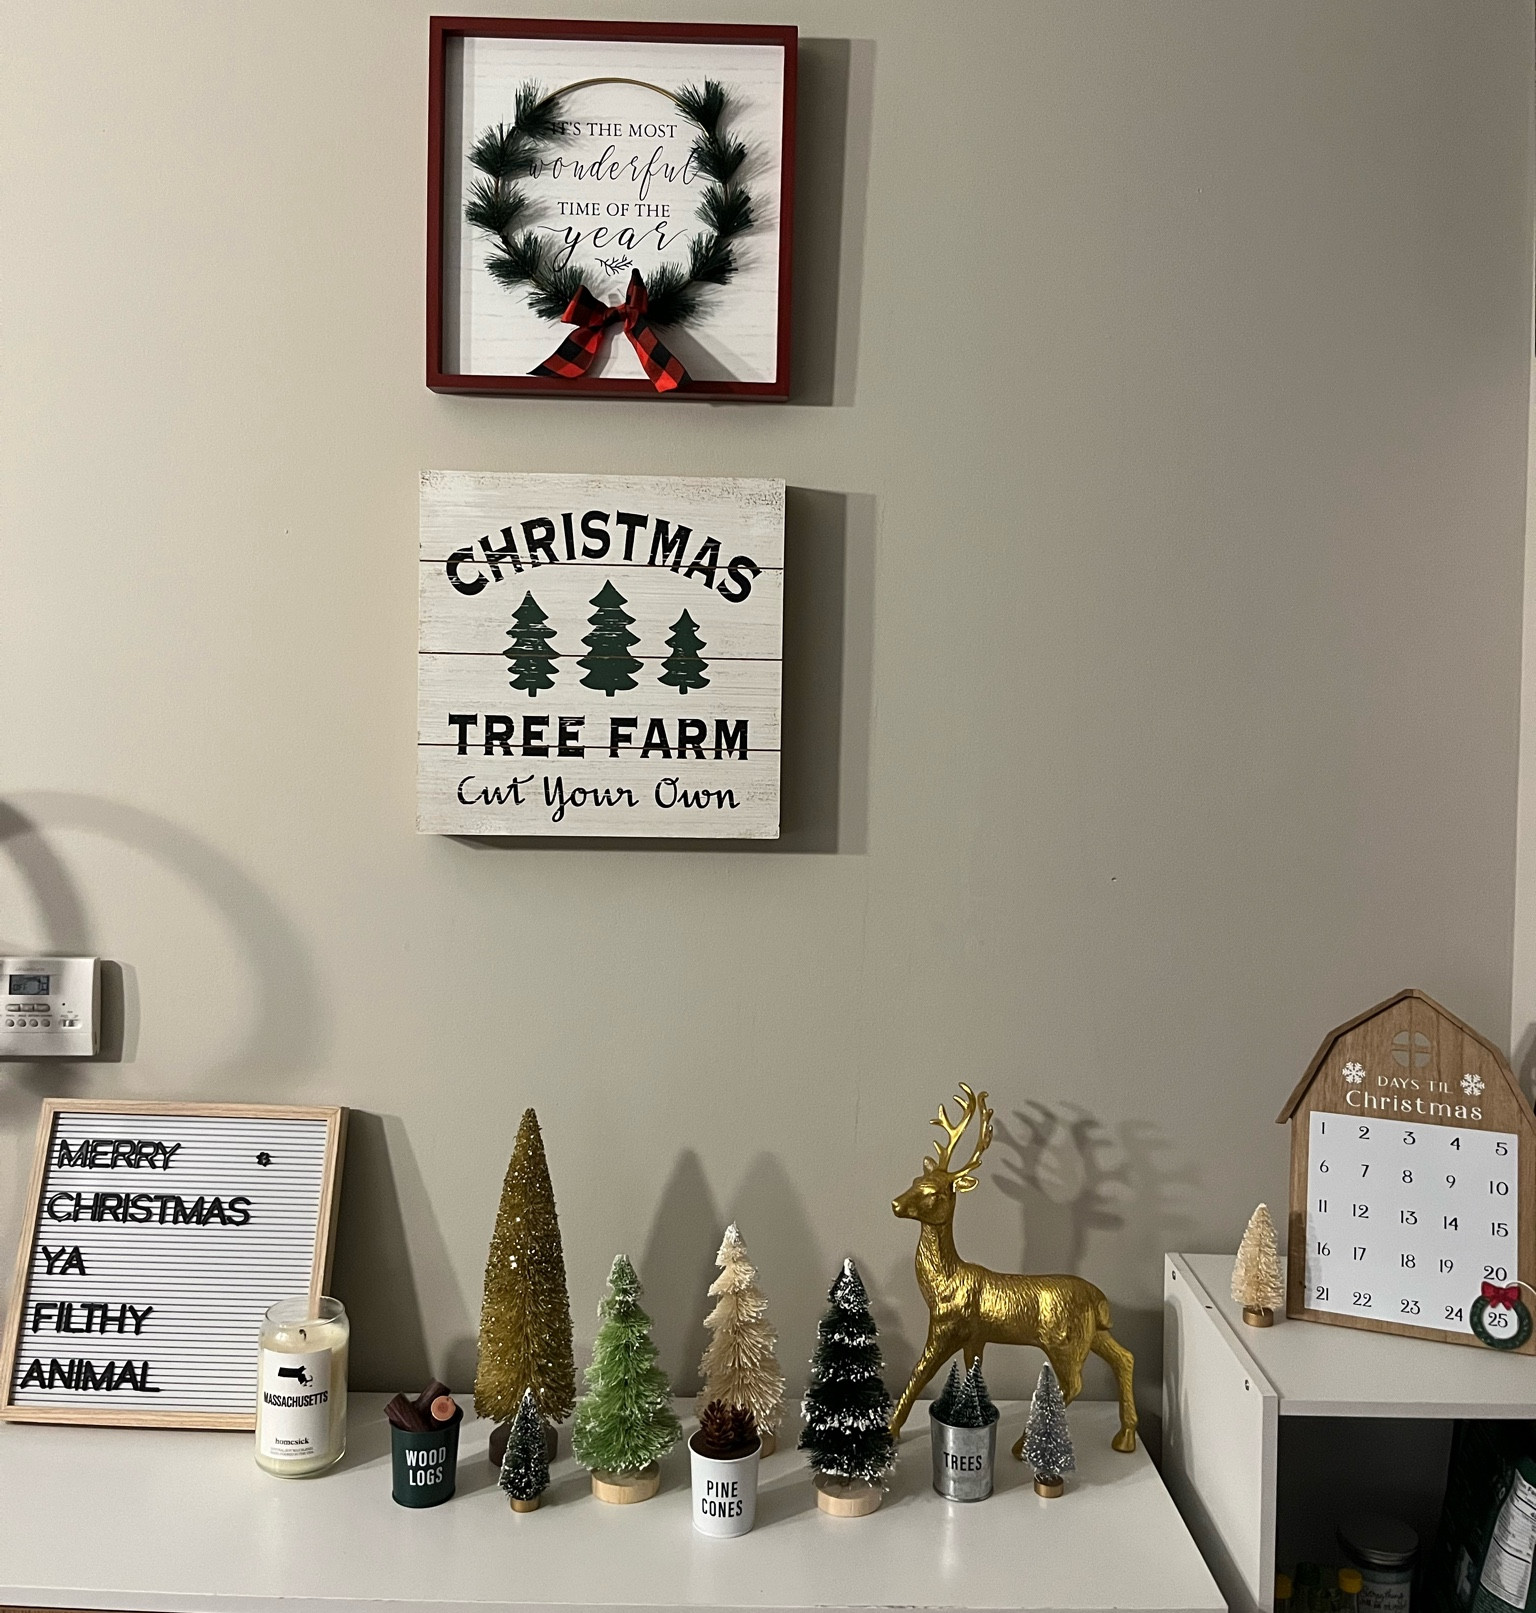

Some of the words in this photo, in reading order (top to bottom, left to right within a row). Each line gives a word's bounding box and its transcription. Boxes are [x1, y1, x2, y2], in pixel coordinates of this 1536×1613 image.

[551, 121, 581, 136] IT'S
[586, 122, 622, 136] THE
[628, 123, 678, 139] MOST
[529, 144, 699, 201] wonderful
[557, 201, 601, 216] TIME
[606, 202, 629, 217] OF
[634, 203, 671, 218] THE
[537, 221, 688, 272] year
[446, 510, 763, 603] CHRISTMAS
[448, 713, 586, 759] TREE
[608, 716, 749, 760] FARM
[457, 774, 534, 805] Cut
[543, 775, 639, 823] Your
[654, 777, 740, 809] Own
[1377, 1075, 1420, 1090] DAYS
[1427, 1080, 1453, 1094] TIL
[1345, 1090, 1482, 1120] Christmas
[57, 1139, 181, 1171] MERRY
[1321, 1121, 1325, 1135] 1
[1358, 1125, 1371, 1140] 2
[1403, 1130, 1416, 1146] 3
[1449, 1137, 1461, 1151] 4
[1495, 1142, 1508, 1157] 5
[1319, 1160, 1330, 1174] 6
[1360, 1164, 1370, 1178] 7
[1401, 1169, 1413, 1184] 8
[1446, 1174, 1456, 1189] 9
[1489, 1180, 1509, 1196] 10
[47, 1192, 252, 1226] CHRISTMAS
[1318, 1199, 1328, 1213] 11
[1352, 1203, 1369, 1219] 12
[1400, 1210, 1418, 1225] 13
[1443, 1216, 1459, 1231] 14
[1491, 1222, 1509, 1238] 15
[41, 1245, 86, 1275] YA
[1317, 1242, 1331, 1257] 16
[1353, 1246, 1367, 1261] 17
[1400, 1254, 1416, 1269] 18
[1439, 1259, 1454, 1274] 19
[1483, 1265, 1508, 1282] 20
[31, 1301, 153, 1335] FILTHY
[1316, 1286, 1329, 1301] 21
[1352, 1292, 1372, 1308] 22
[1400, 1299, 1421, 1315] 23
[1444, 1306, 1463, 1322] 24
[1488, 1312, 1508, 1328] 25
[20, 1358, 161, 1392] ANIMAL
[263, 1390, 328, 1407] MASSACHUSETTS
[275, 1437, 310, 1446] homesick
[405, 1446, 446, 1467] WOOD
[409, 1466, 443, 1486] LOGS
[943, 1451, 982, 1471] TREES
[706, 1480, 738, 1498] PINE
[701, 1498, 743, 1518] CONES
